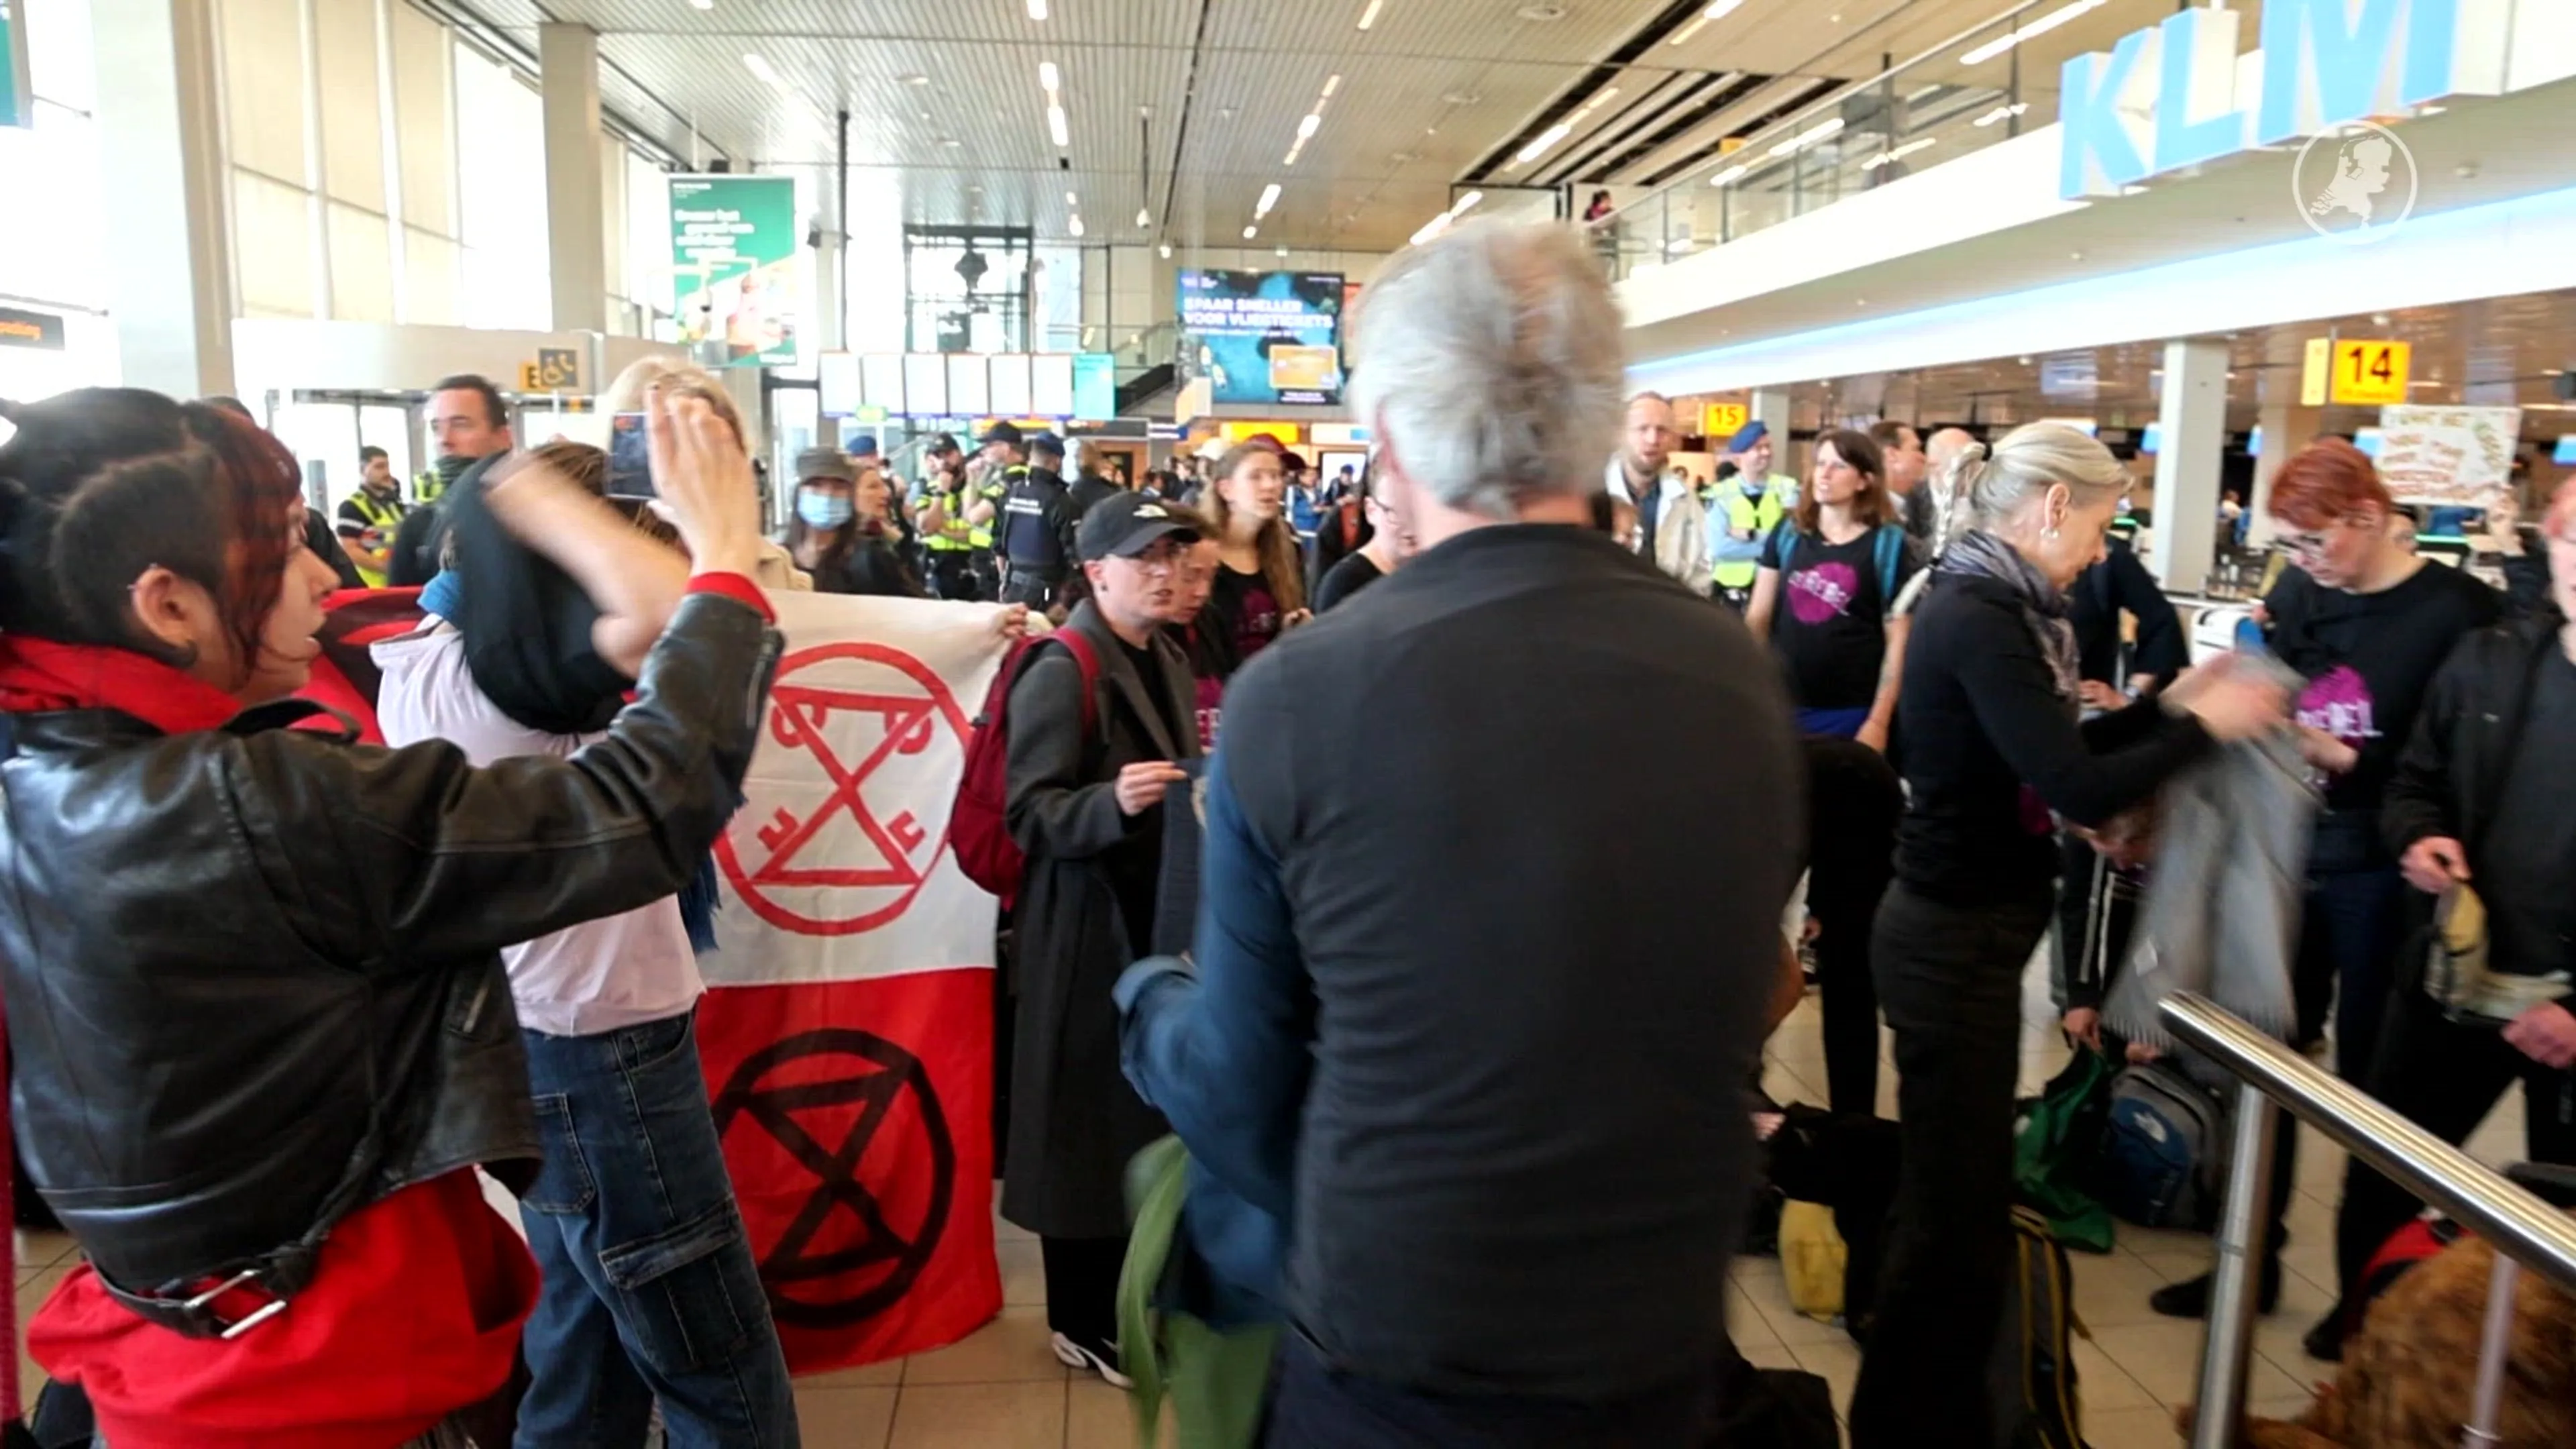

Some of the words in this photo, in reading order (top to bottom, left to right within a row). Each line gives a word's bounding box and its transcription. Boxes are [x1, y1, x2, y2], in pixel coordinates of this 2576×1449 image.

[2059, 0, 2461, 199] KLM
[1184, 297, 1233, 311] SPAAR
[1236, 299, 1302, 312] SNELLER
[1184, 313, 1226, 324] VOOR
[2348, 346, 2394, 384] 14
[527, 366, 539, 388] E
[1715, 407, 1738, 425] 15
